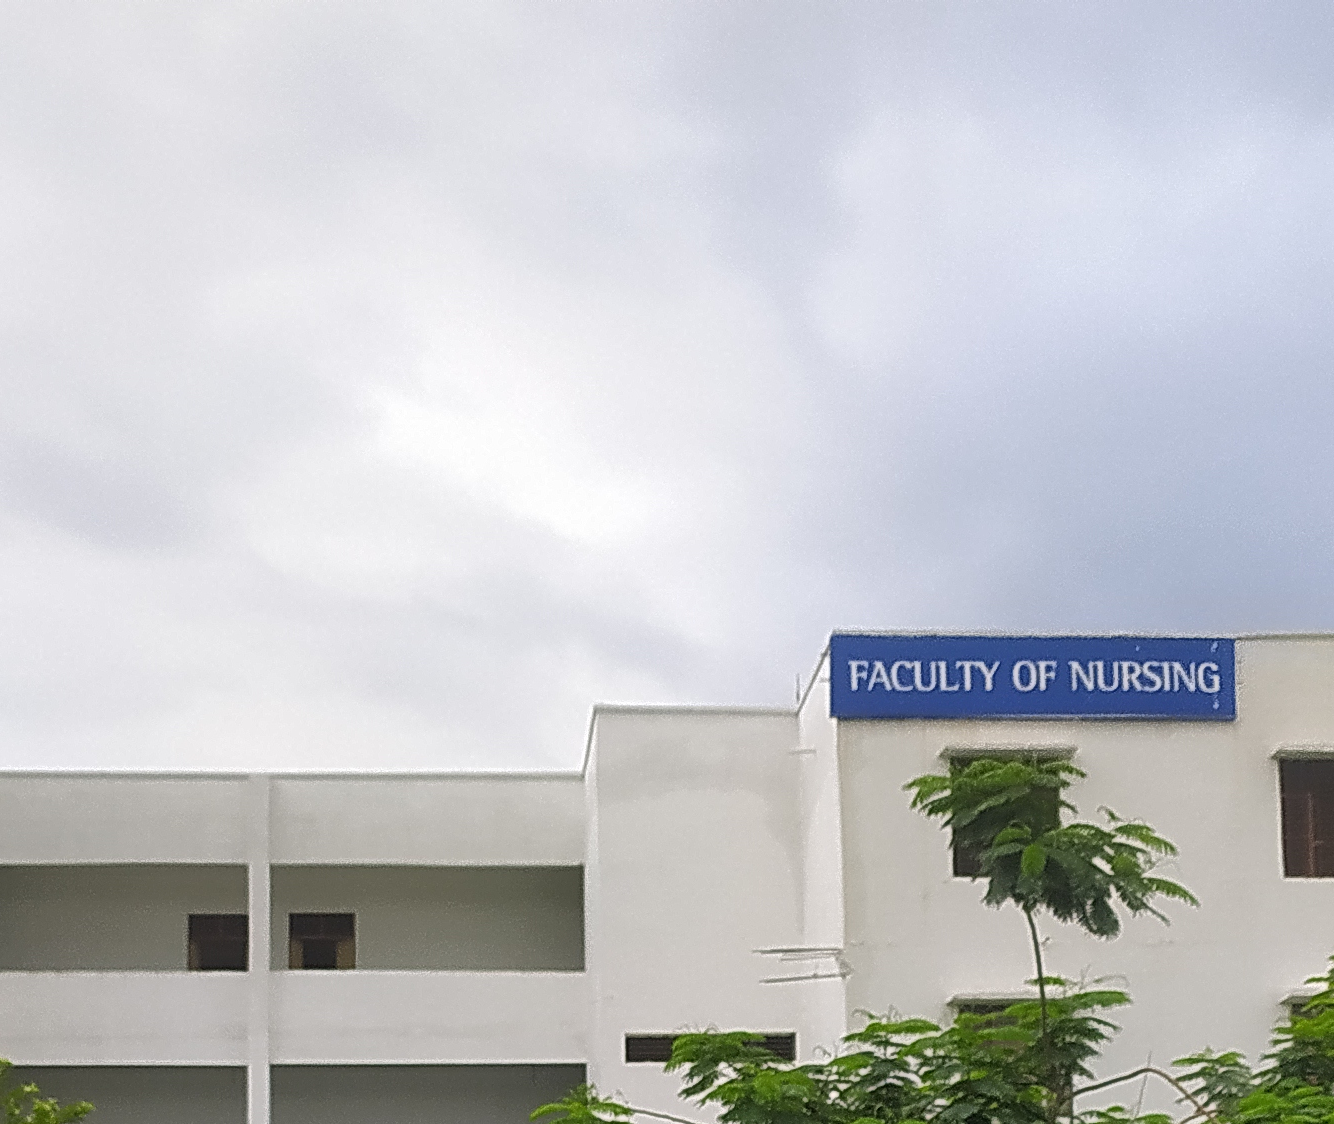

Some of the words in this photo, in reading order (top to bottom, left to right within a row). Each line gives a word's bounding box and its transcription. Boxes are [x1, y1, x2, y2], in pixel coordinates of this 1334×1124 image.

[848, 660, 1001, 693] FACULTY
[1012, 660, 1058, 693] OF
[1068, 660, 1221, 694] NURSING
